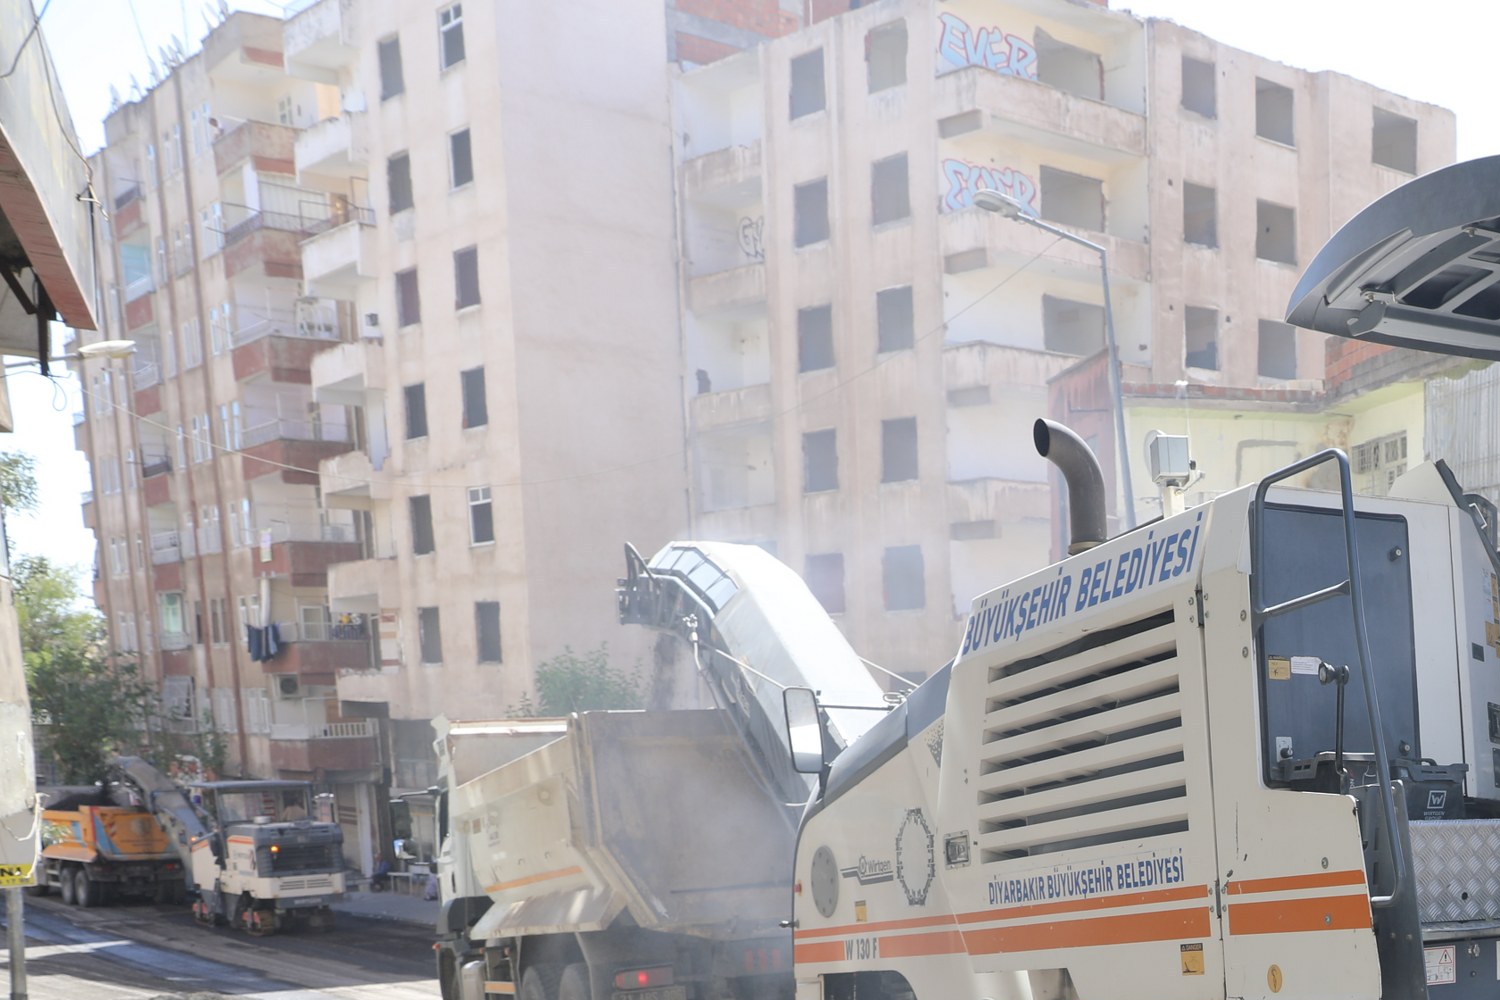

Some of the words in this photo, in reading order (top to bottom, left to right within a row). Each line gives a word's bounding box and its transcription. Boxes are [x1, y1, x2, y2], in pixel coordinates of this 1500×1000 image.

[962, 566, 1072, 656] BÜYÜKŞEHİR
[1075, 511, 1202, 613] BELEDİYESİ
[989, 875, 1046, 905] DİYARBAKIR
[1047, 860, 1114, 899] BÜYÜKŞEHİR
[1117, 848, 1184, 890] BELEDİYESİ
[856, 938, 871, 960] 130
